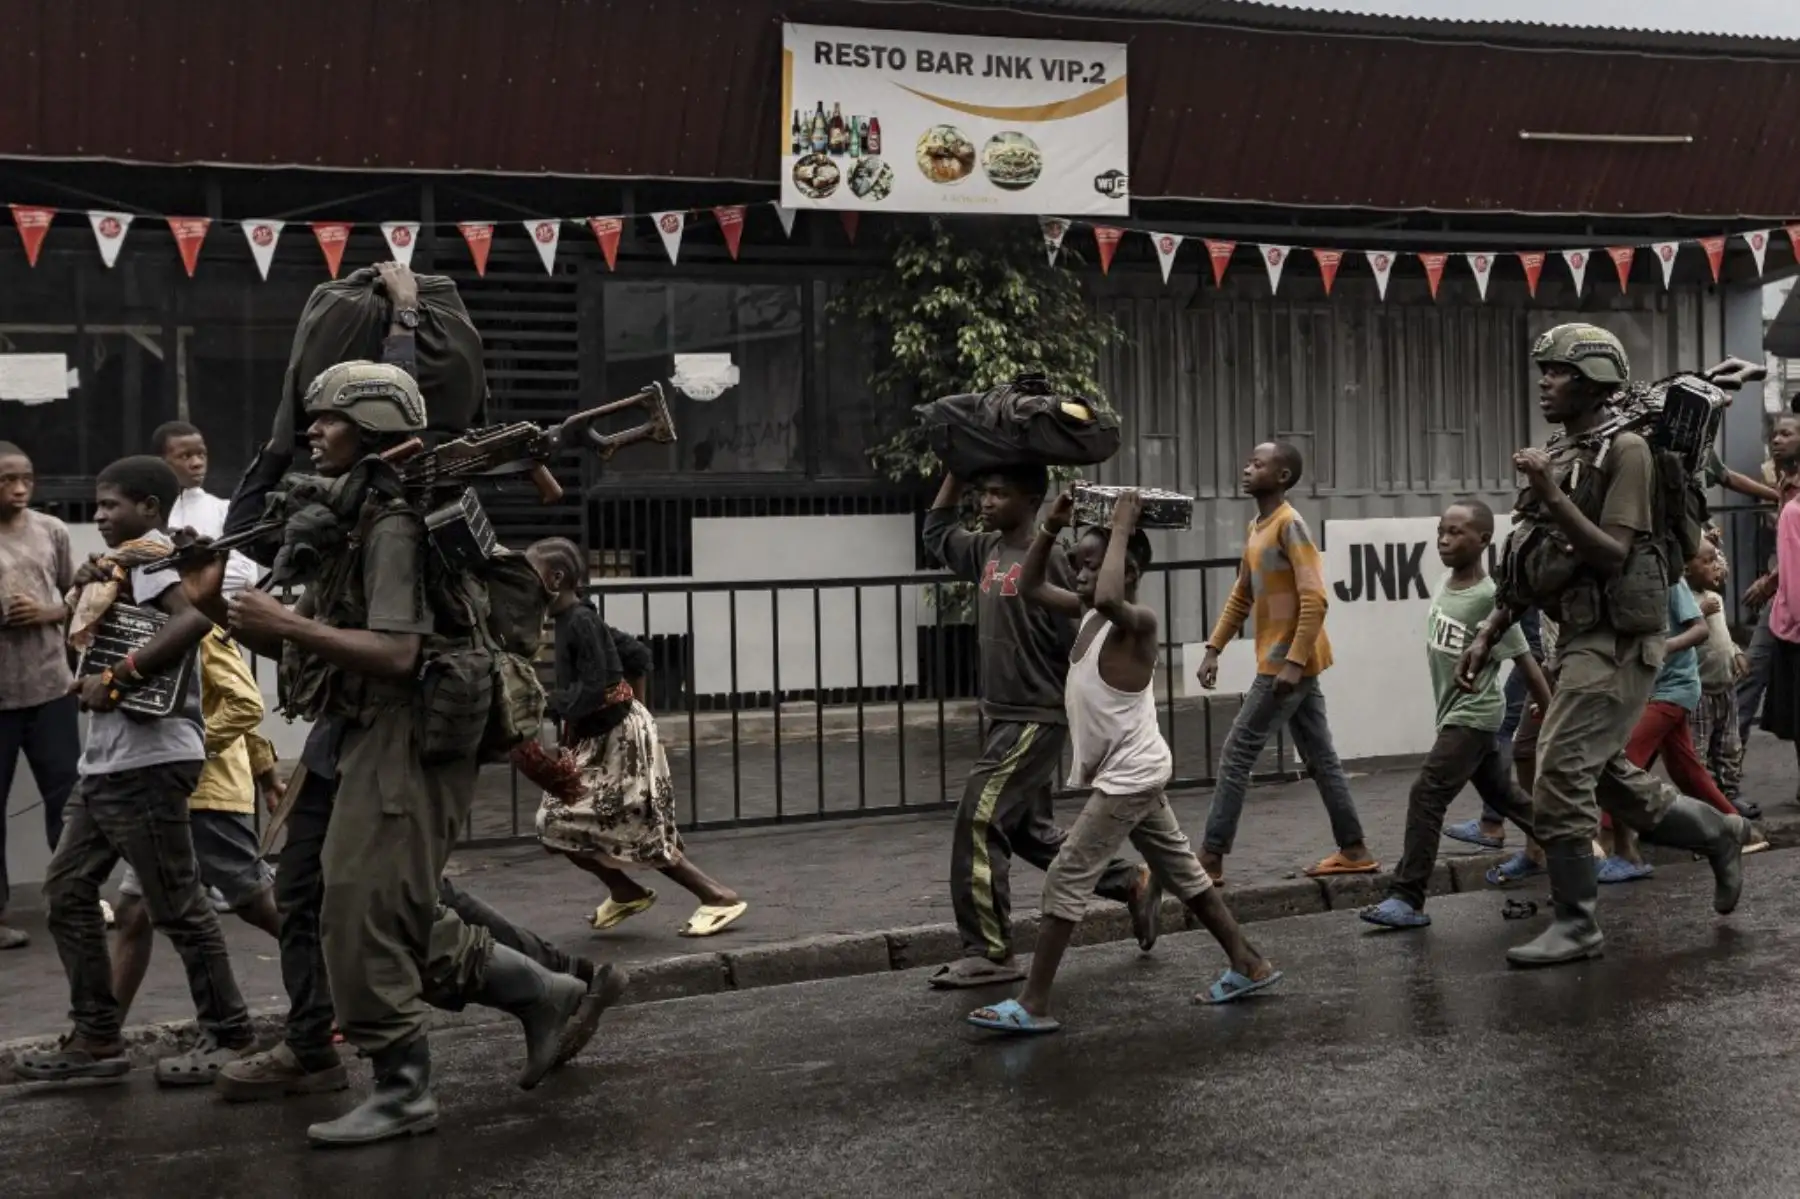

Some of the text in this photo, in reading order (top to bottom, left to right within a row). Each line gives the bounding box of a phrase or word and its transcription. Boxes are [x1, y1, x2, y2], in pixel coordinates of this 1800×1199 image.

[814, 40, 1106, 84] RESTO BAR JNK VIP.2
[1333, 541, 1431, 603] JNK
